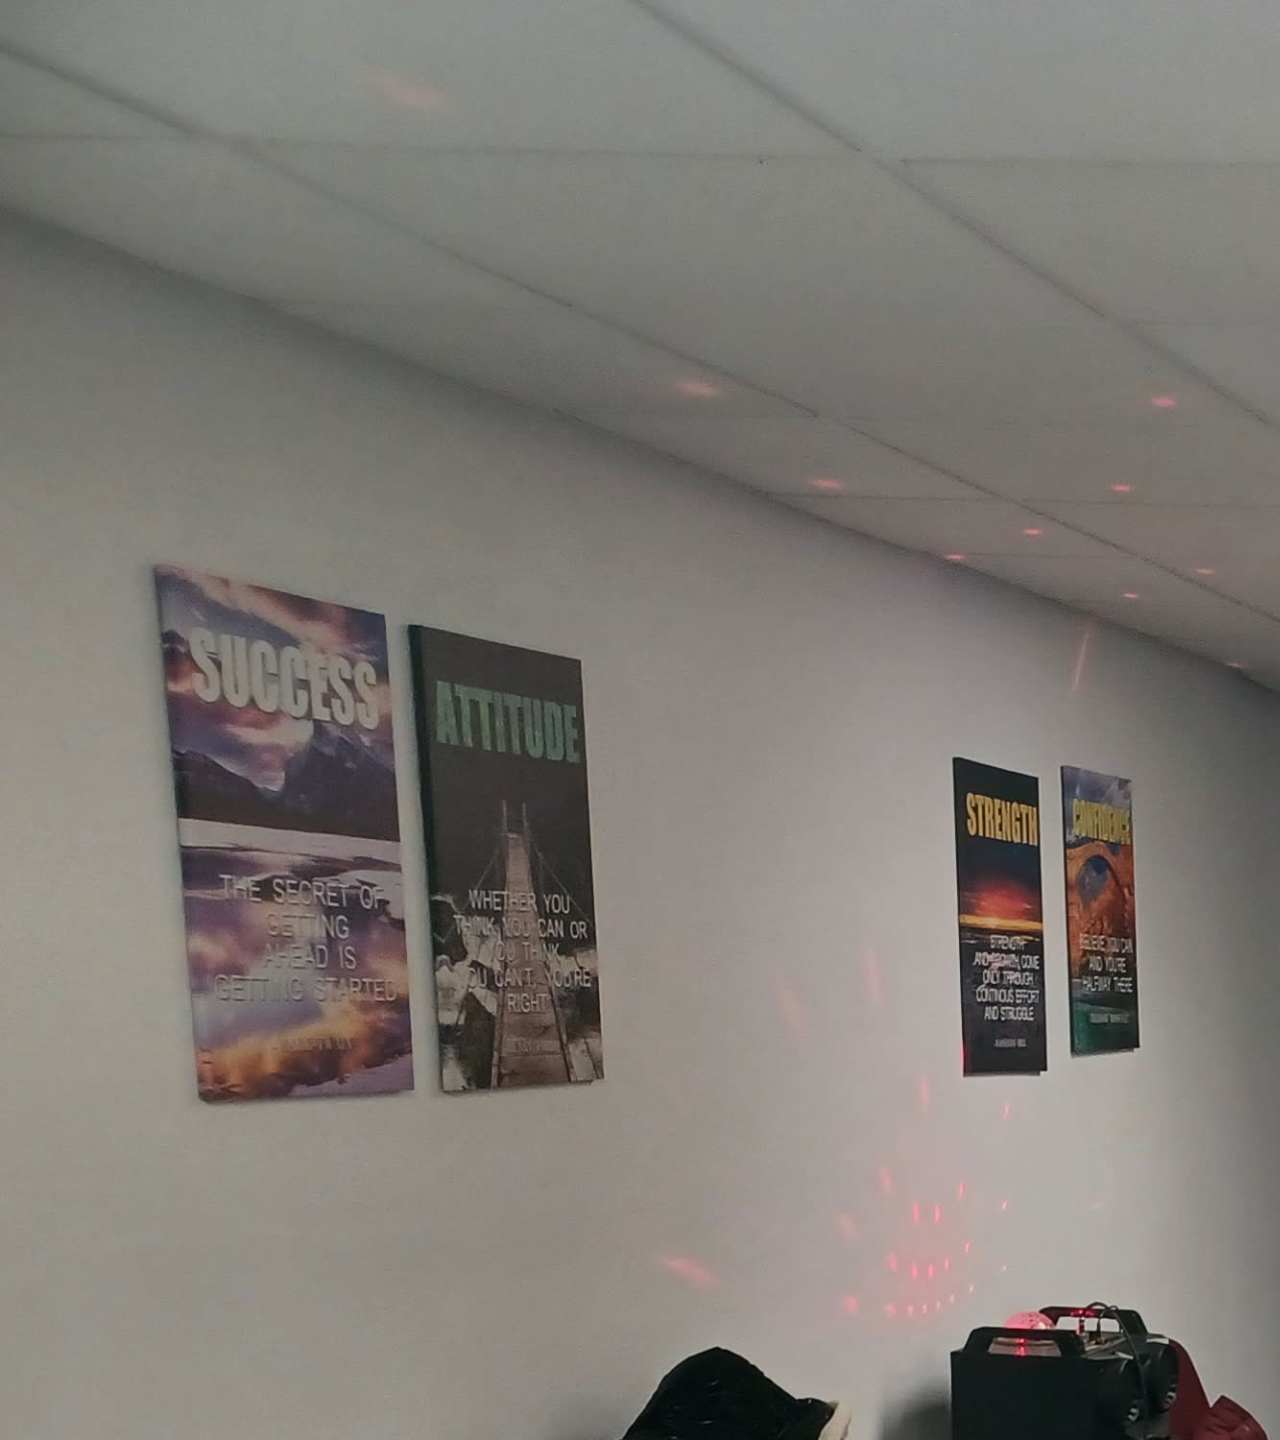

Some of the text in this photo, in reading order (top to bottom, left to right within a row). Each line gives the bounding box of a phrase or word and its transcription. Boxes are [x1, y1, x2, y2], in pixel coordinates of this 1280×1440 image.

[188, 626, 380, 731] SUCCESS
[434, 680, 582, 764] ATTITUDE
[966, 791, 1039, 846] STRENGTH
[219, 873, 387, 911] THE SECRET OF
[468, 889, 570, 914] WHETHER YOU
[265, 912, 350, 941] GETTING
[502, 917, 533, 938] YOU
[537, 918, 565, 939] CAN
[569, 921, 589, 940] OR
[263, 942, 358, 971] AHEAD IS
[522, 942, 561, 965] THINK
[214, 974, 400, 1002] GETTING STARTED
[507, 992, 550, 1014] RIGHT
